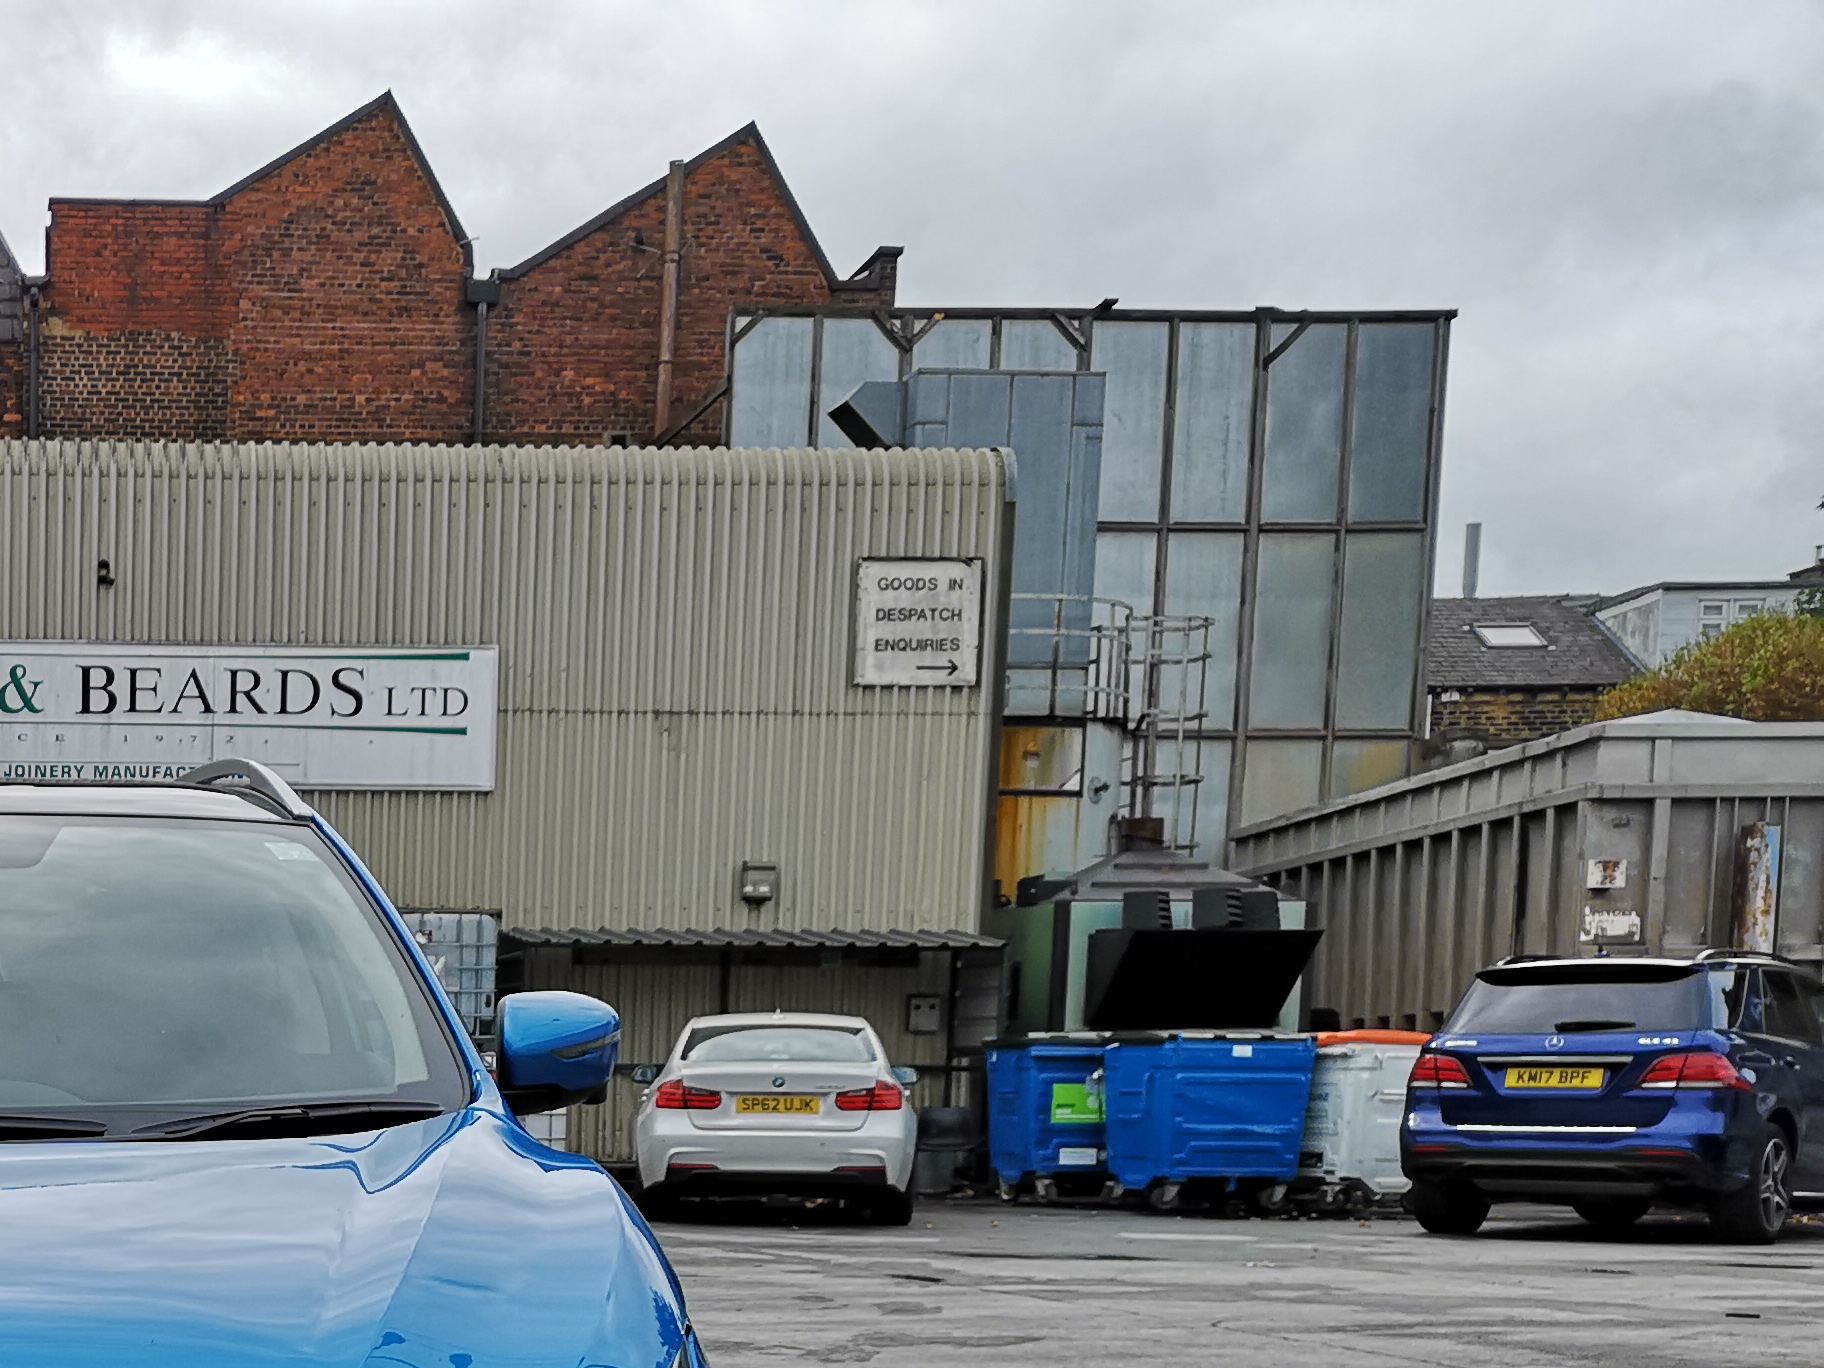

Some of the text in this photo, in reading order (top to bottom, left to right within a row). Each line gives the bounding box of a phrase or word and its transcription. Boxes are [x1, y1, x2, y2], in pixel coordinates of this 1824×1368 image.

[877, 577, 964, 591] GOODS IN
[875, 607, 963, 622] DESPATCH
[874, 637, 961, 652] ENQUIRIES
[75, 664, 366, 718] BEARDS
[383, 686, 469, 717] LTD
[3, 763, 84, 778] JOINERY
[93, 764, 198, 779] MANUFAC
[1516, 1069, 1592, 1084] KM17 BPF
[742, 1097, 814, 1111] SP62 UJK
